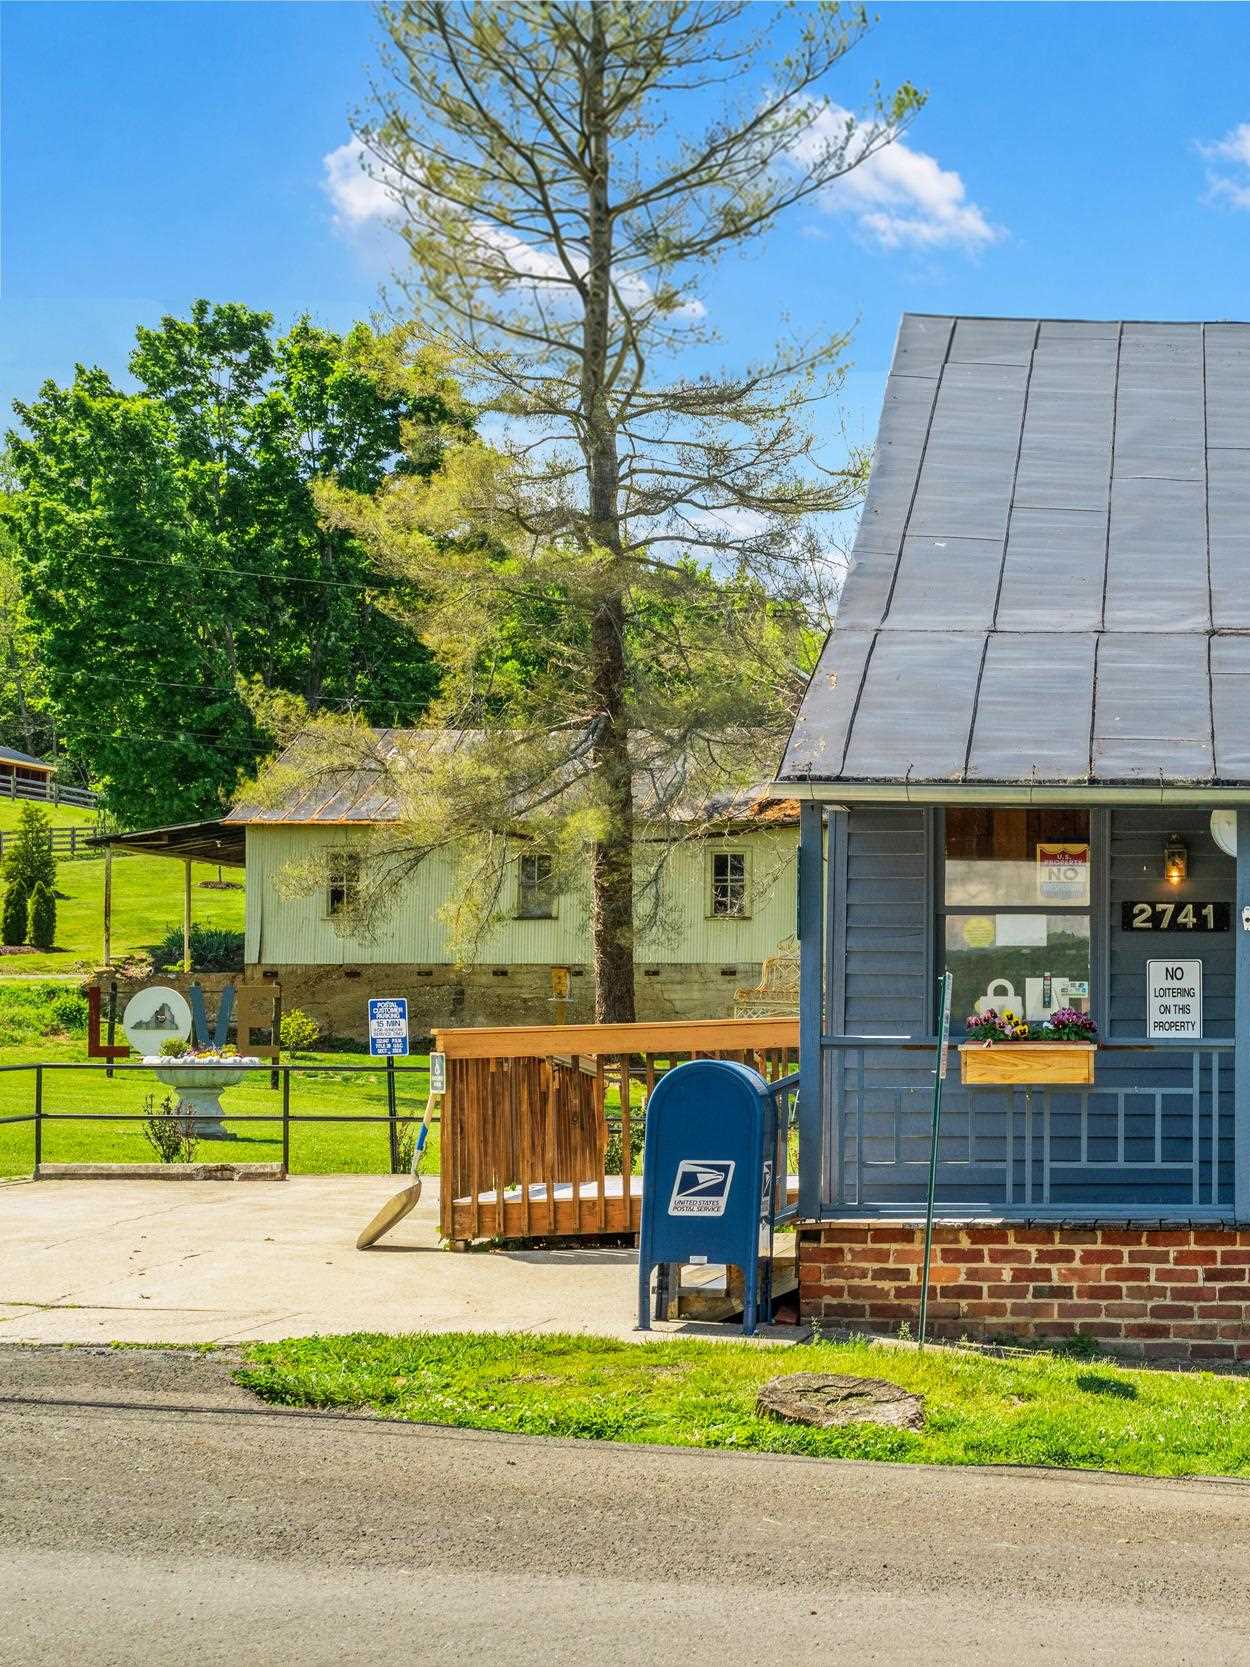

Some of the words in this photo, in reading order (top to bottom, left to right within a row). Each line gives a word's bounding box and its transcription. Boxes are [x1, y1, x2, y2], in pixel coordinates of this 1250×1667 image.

[1048, 867, 1079, 881] NO
[1132, 903, 1214, 929] 2741
[1165, 966, 1184, 981] NO
[1154, 987, 1196, 998] LOITERING
[1158, 1004, 1171, 1015] ON
[1173, 1004, 1191, 1015] THIS
[1153, 1021, 1196, 1032] PROPERTY
